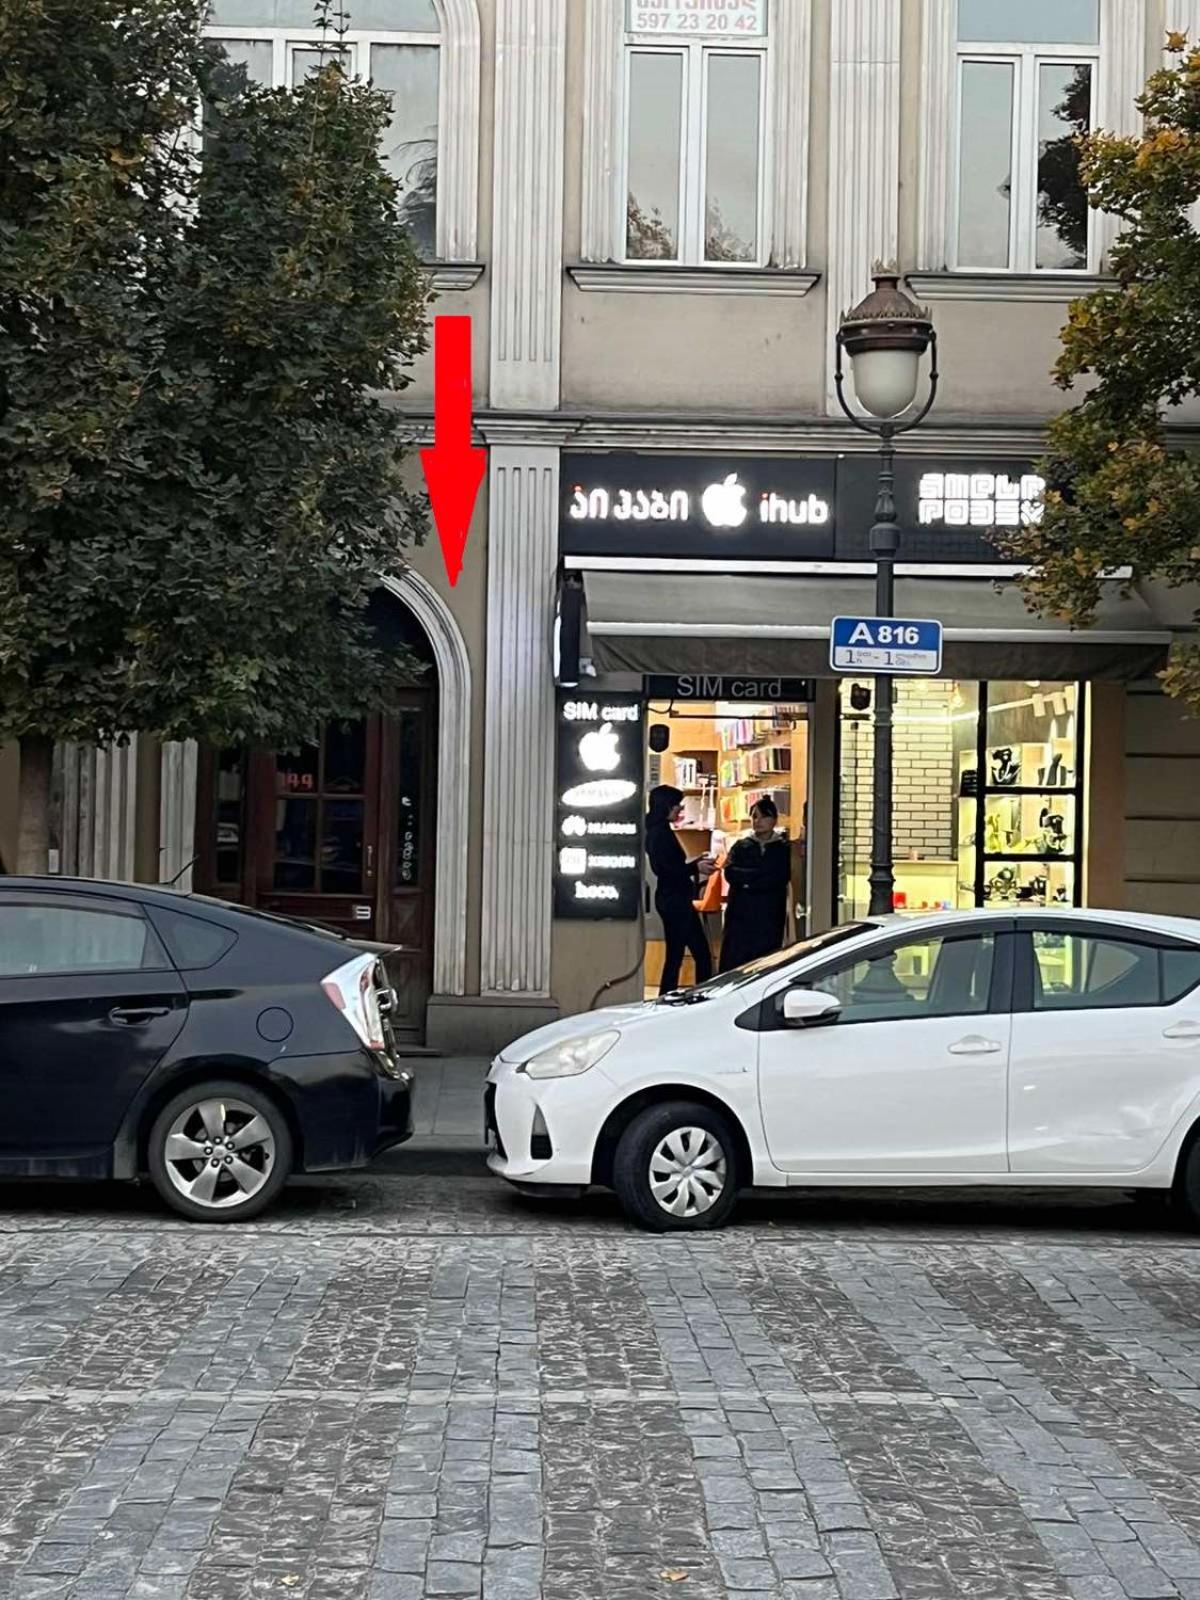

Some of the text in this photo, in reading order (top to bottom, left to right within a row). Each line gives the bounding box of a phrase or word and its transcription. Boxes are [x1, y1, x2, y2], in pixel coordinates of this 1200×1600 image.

[637, 13, 757, 30] 597 23 20 42
[760, 492, 828, 524] ihub
[848, 622, 919, 645] A 816
[677, 675, 782, 698] SIM card
[563, 702, 639, 721] SIM card
